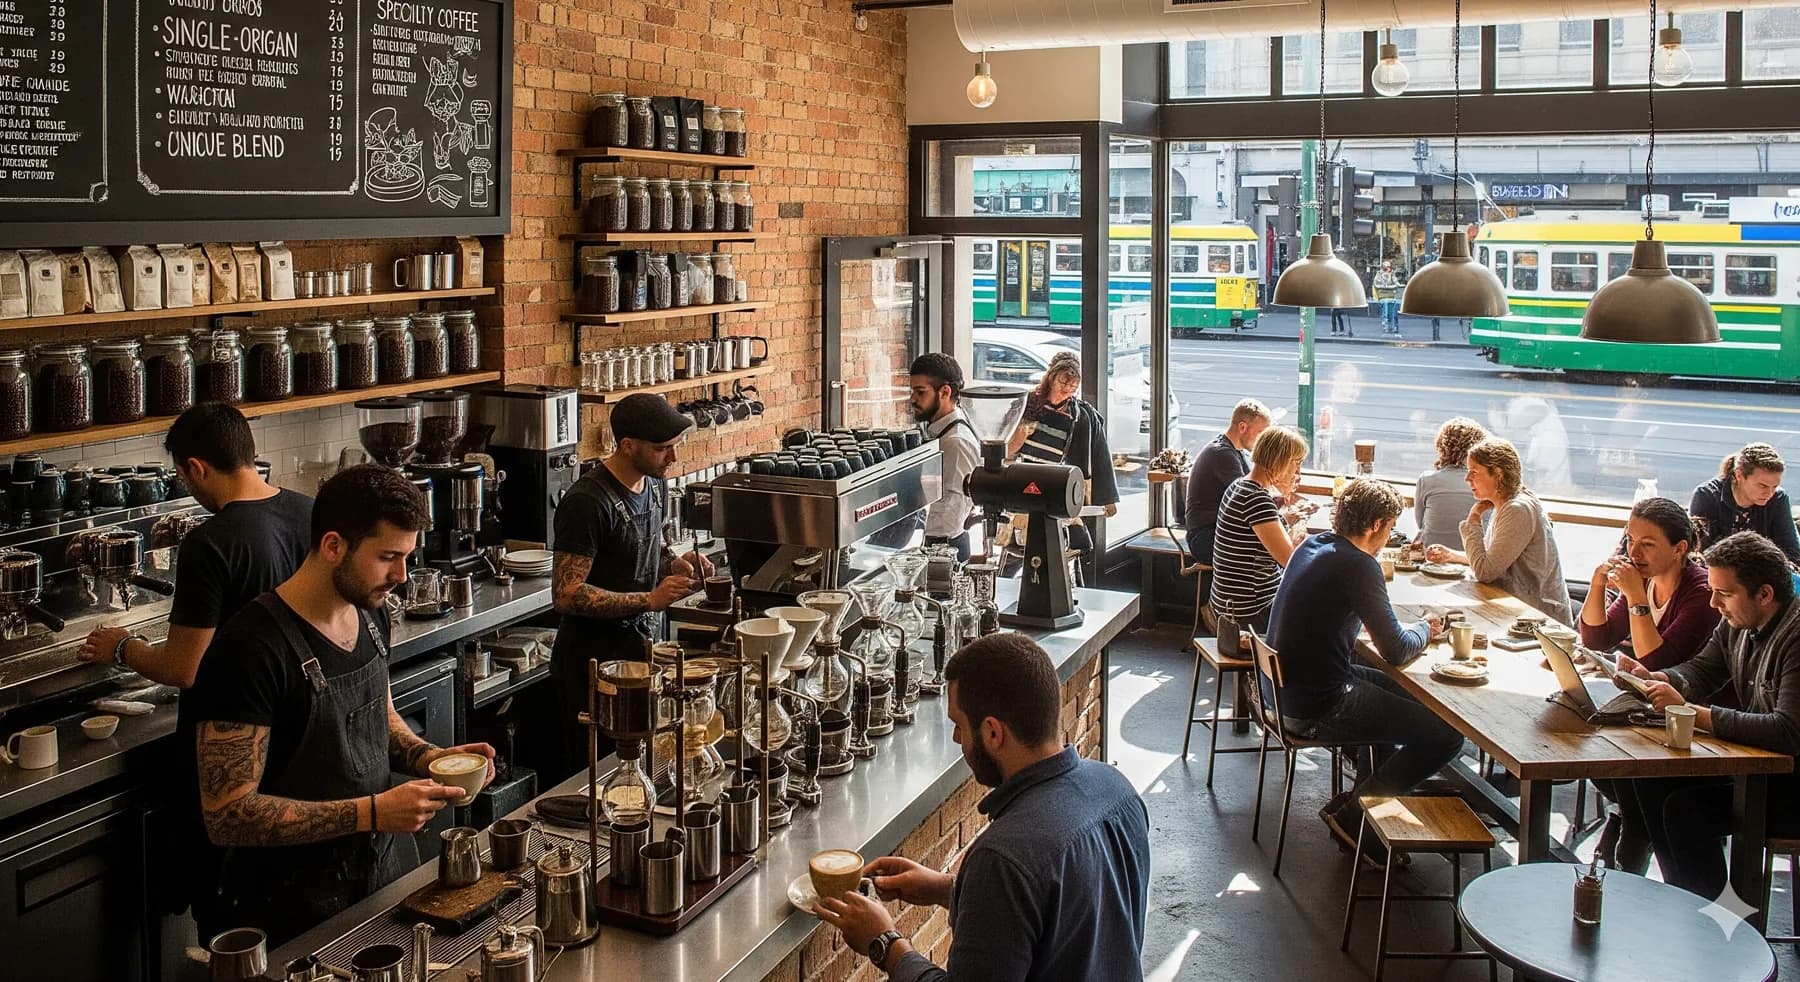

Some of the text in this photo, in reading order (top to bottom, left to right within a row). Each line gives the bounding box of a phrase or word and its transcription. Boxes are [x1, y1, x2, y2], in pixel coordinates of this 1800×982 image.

[437, 8, 480, 33] COFFEE
[162, 16, 298, 58] SINGLE-ORIGAN
[232, 133, 285, 158] BLEND
